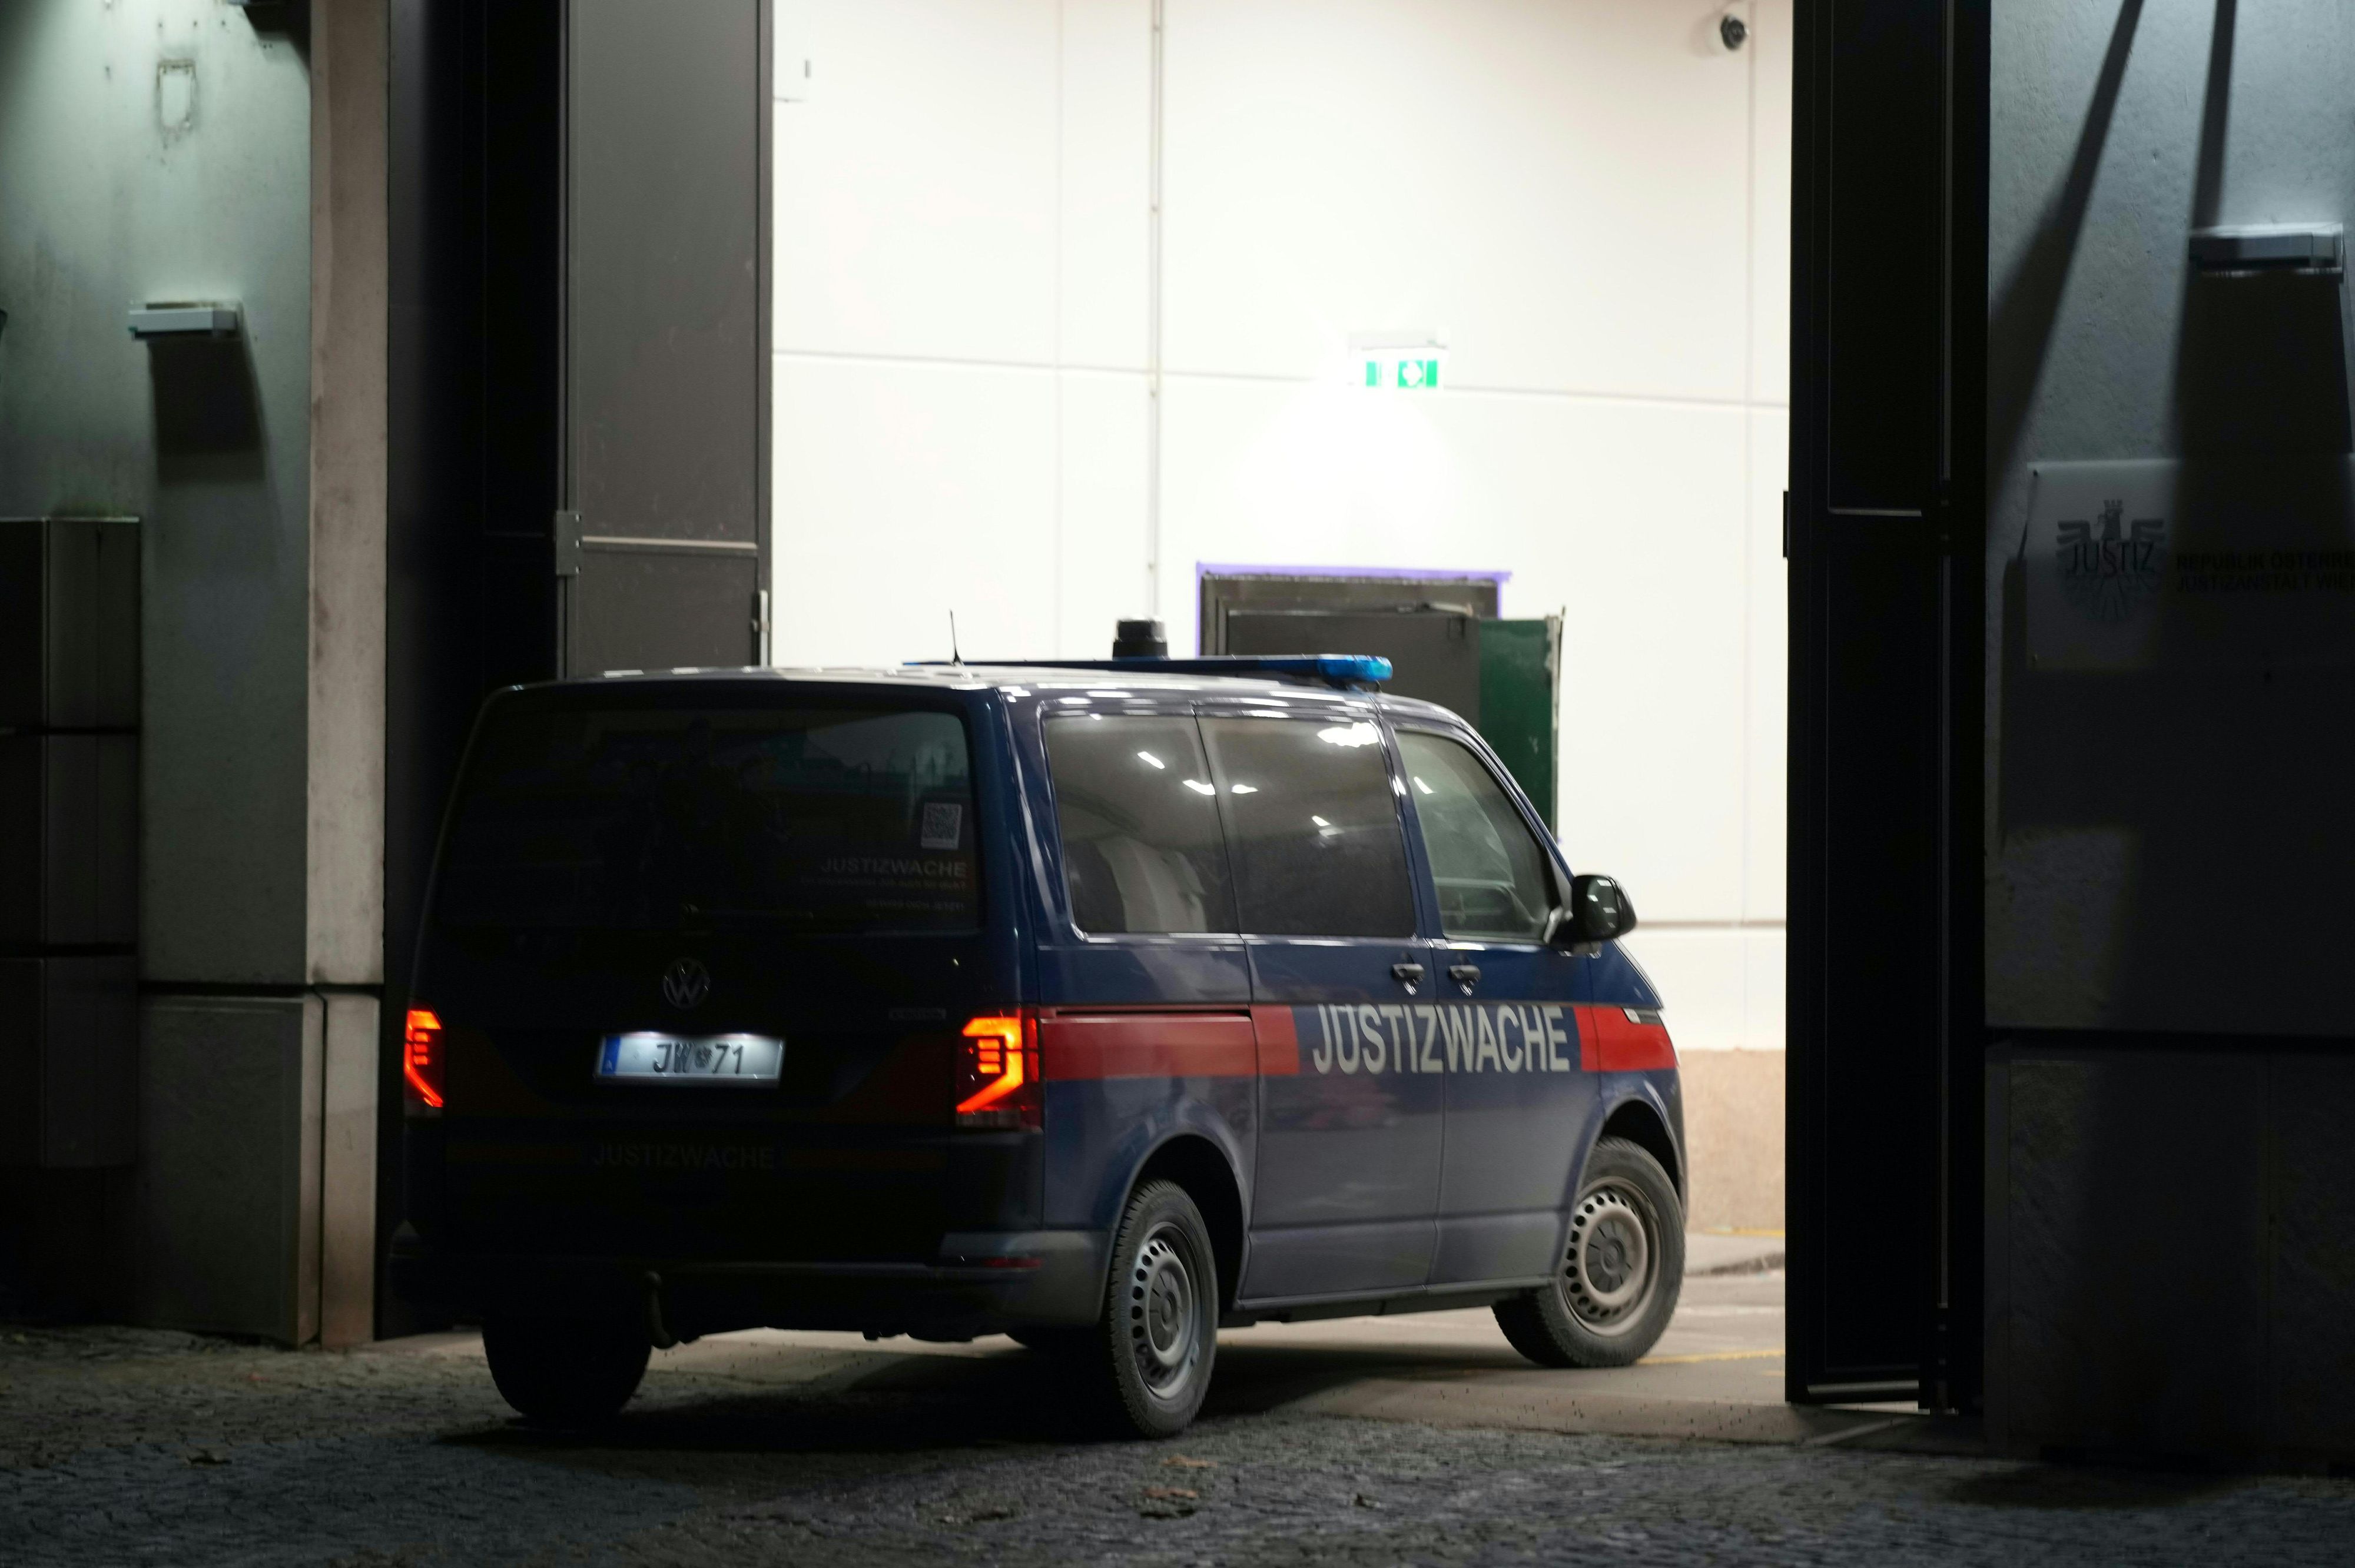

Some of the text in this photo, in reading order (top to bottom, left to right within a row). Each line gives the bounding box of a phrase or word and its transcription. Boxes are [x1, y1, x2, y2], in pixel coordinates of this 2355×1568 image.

[2177, 552, 2264, 570] REPUBLIK
[821, 857, 967, 878] JUSTIZWACHE
[1312, 1003, 1570, 1075] JUSTIZWACHE
[711, 1044, 744, 1074] 71
[592, 1142, 775, 1170] JUSTIZWACHE
